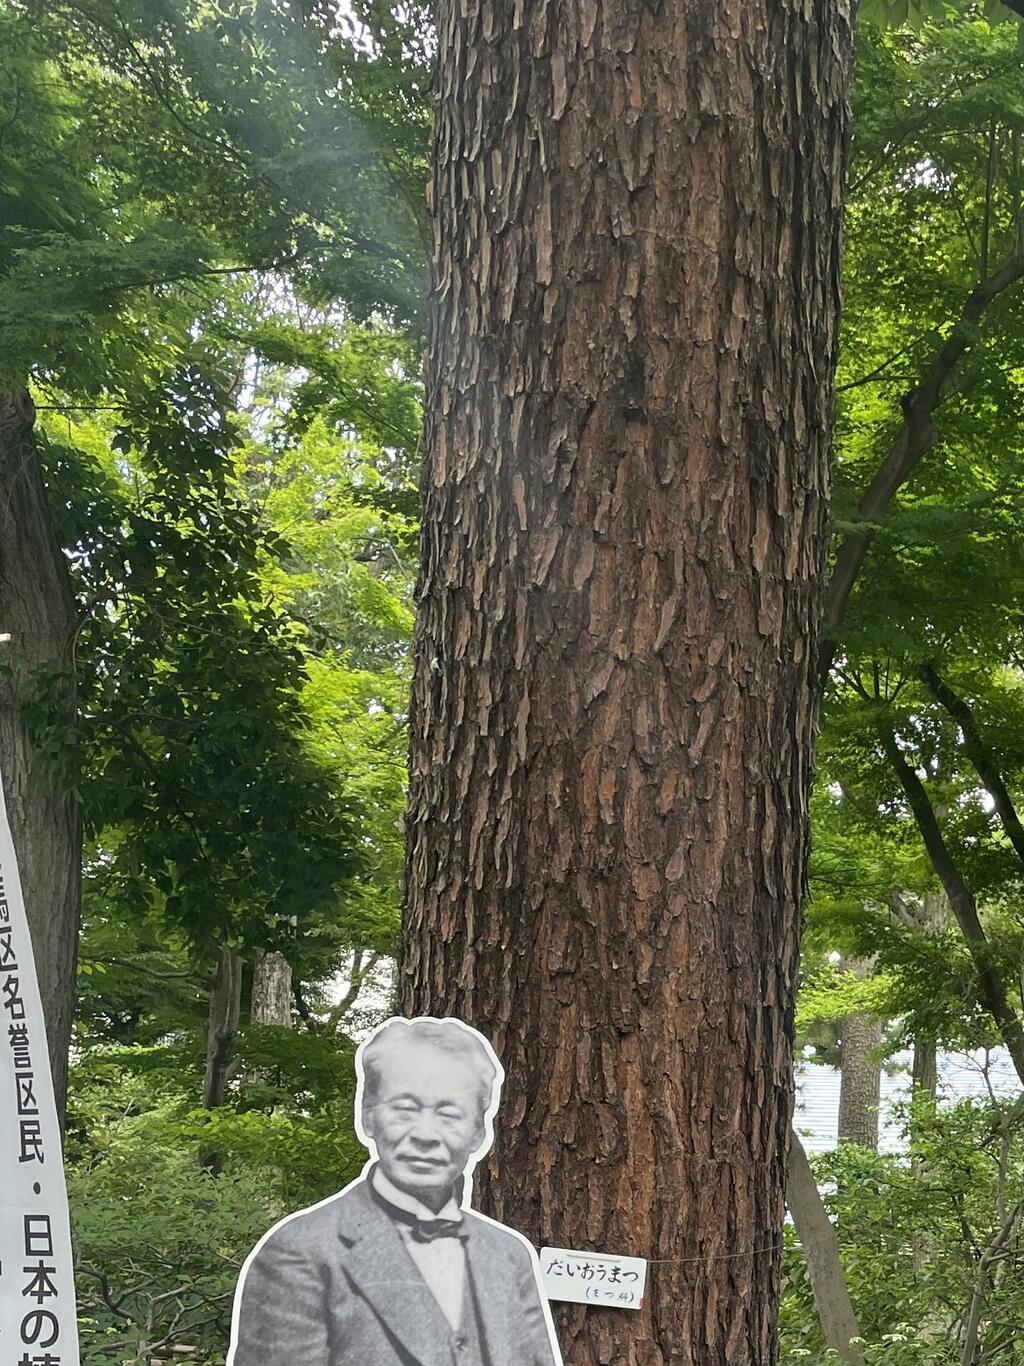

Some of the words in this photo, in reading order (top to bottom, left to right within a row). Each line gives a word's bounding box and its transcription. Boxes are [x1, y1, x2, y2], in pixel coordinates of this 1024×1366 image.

[546, 1259, 639, 1284] だいおうまつ
